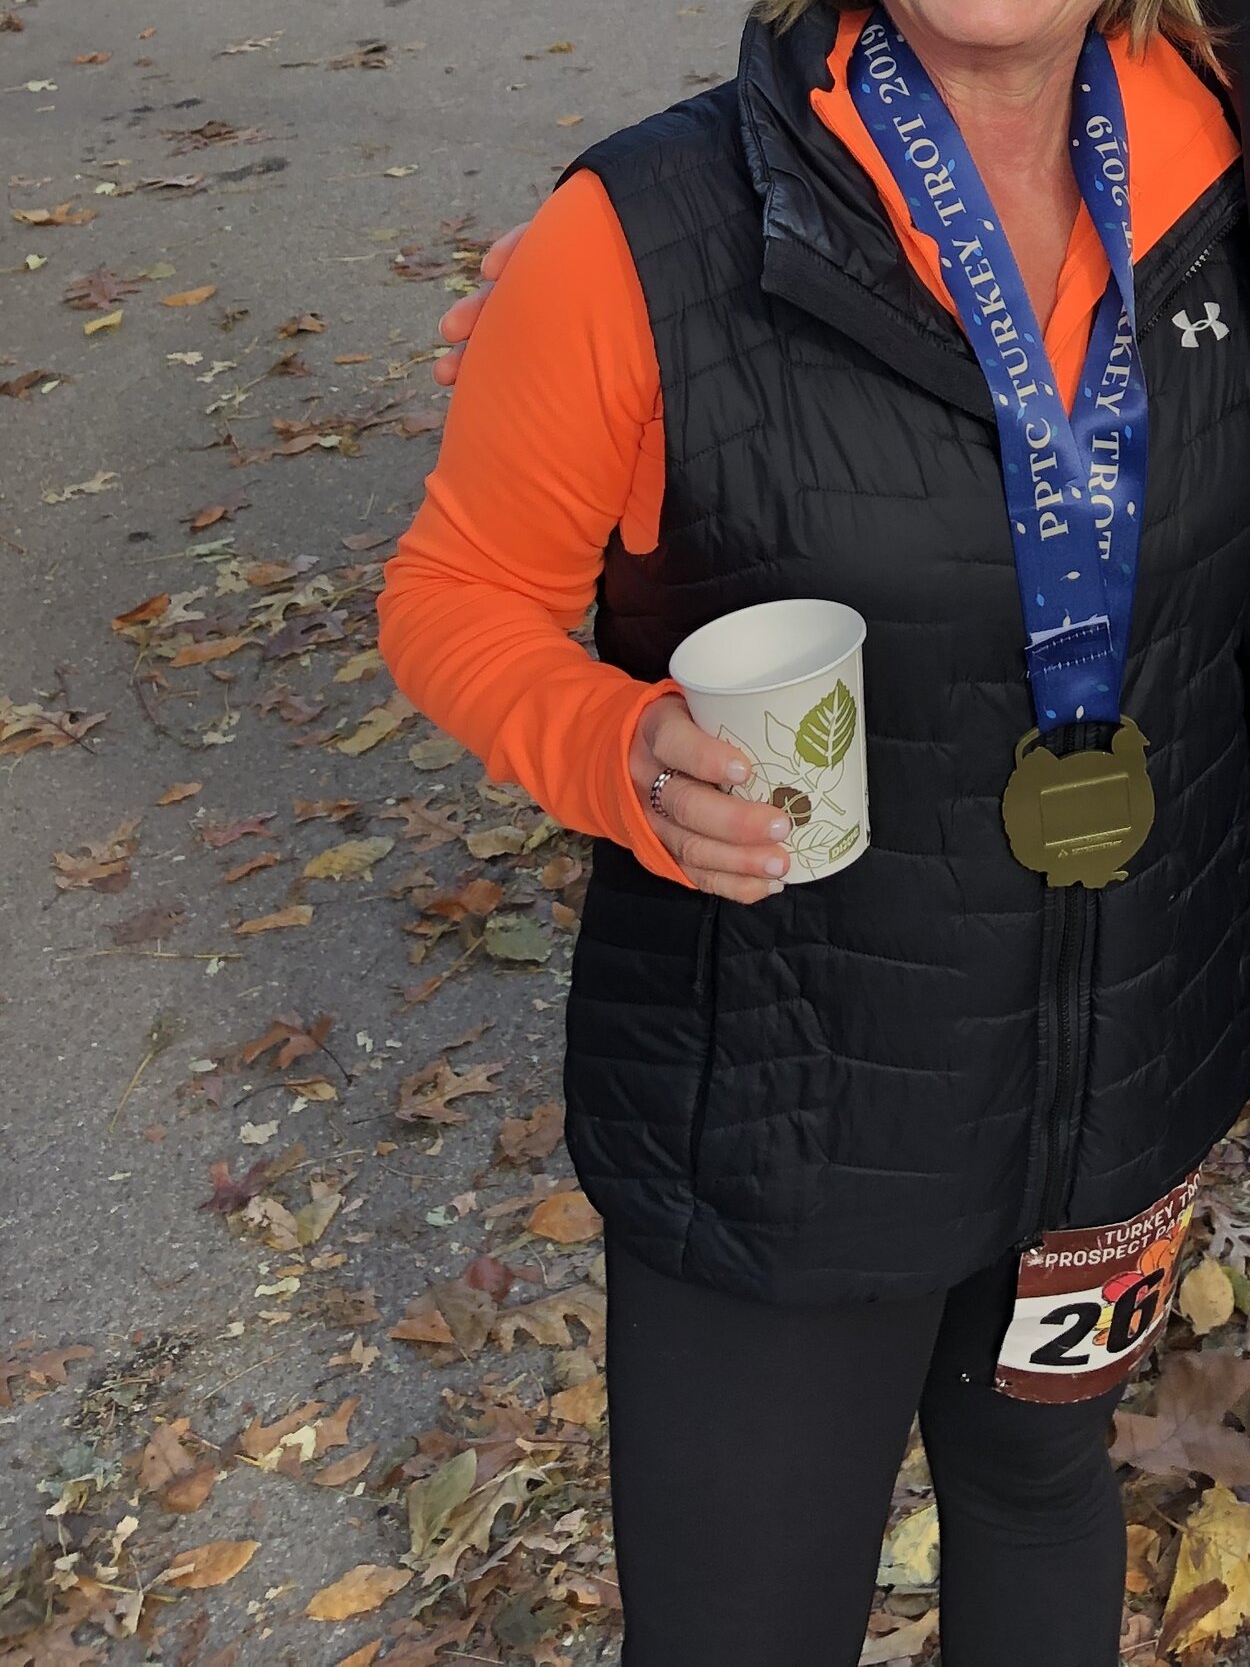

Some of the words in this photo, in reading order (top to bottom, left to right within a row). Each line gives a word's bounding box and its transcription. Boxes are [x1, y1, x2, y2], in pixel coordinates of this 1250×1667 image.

[860, 24, 911, 104] 2019
[892, 113, 967, 227] TROT
[1086, 115, 1132, 207] 2019
[951, 235, 1040, 406] TURKEY
[1025, 417, 1070, 541] PPTC
[1045, 1235, 1149, 1268] PROSPECT
[1105, 1201, 1175, 1245] TURKEY
[1029, 1267, 1164, 1366] 26
